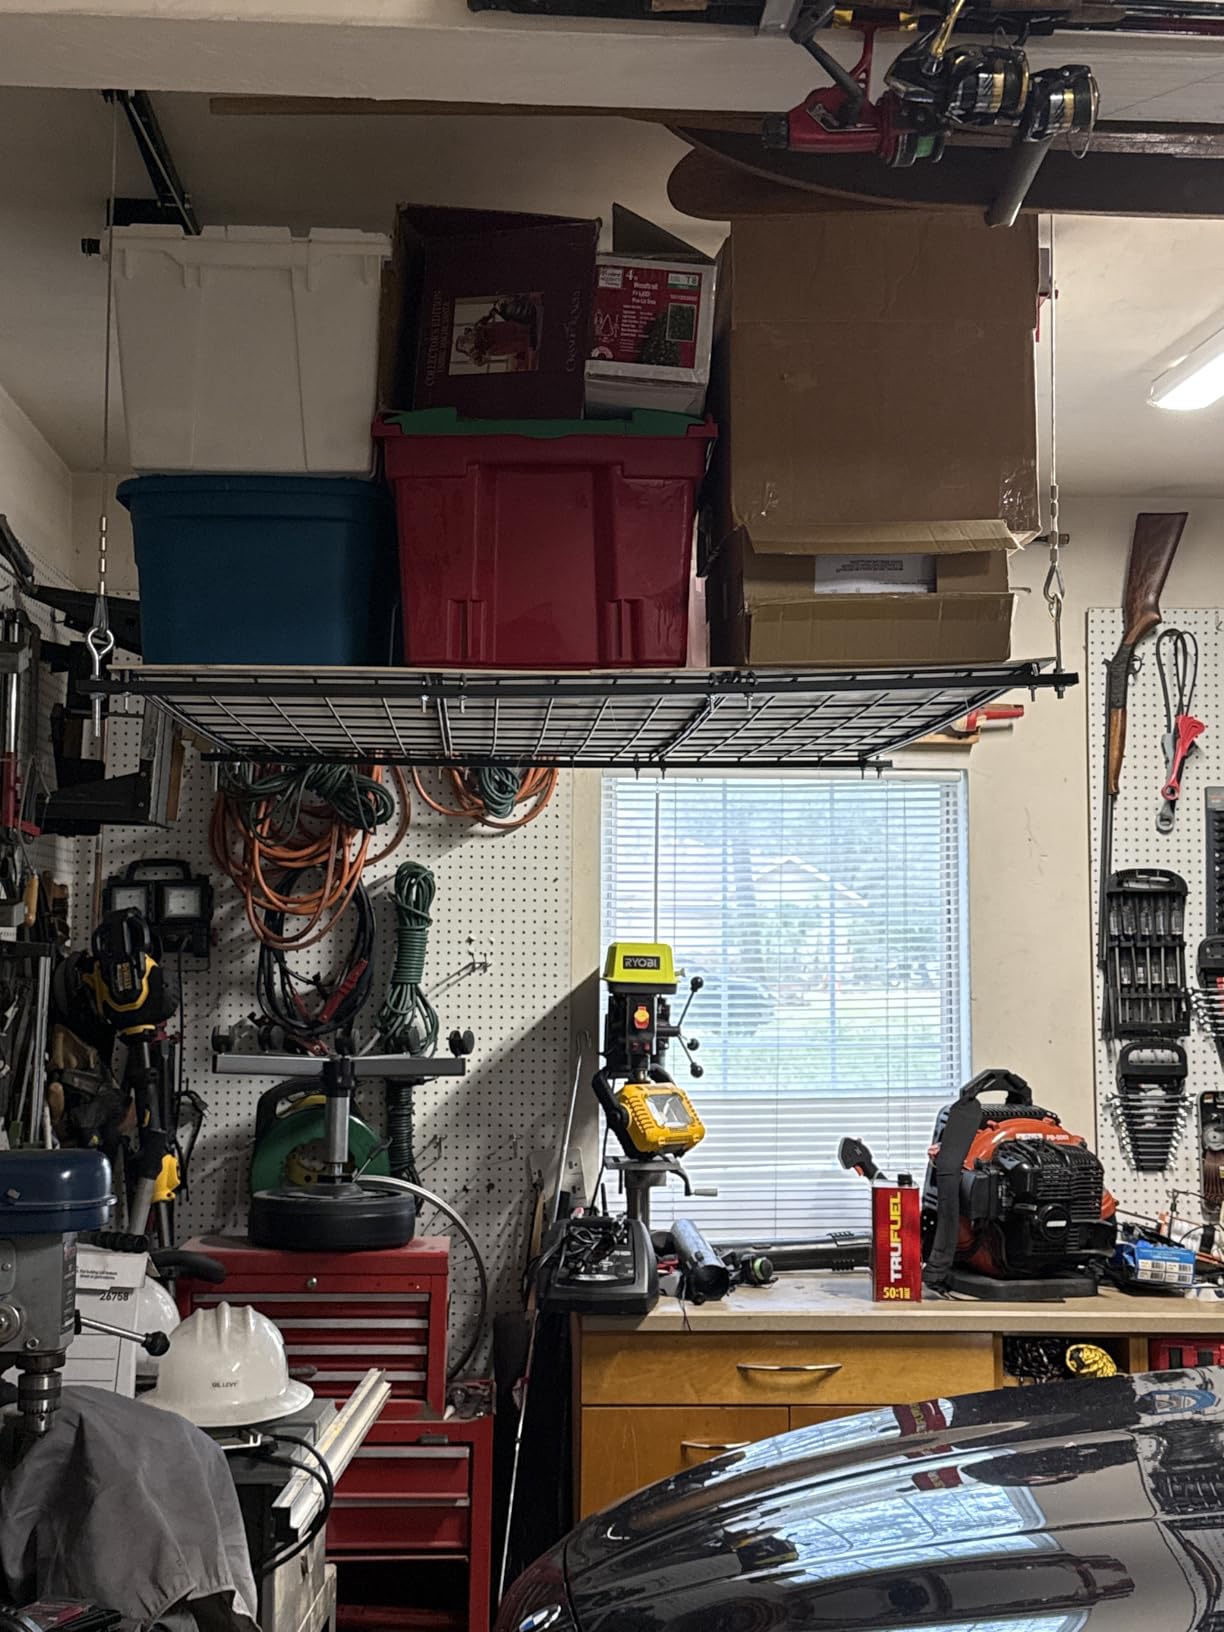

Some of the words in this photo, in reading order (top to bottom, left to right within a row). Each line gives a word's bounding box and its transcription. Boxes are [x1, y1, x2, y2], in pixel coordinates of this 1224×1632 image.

[625, 958, 658, 968] RYOBI
[890, 1191, 902, 1283] TRUFUEL
[100, 1291, 129, 1301] 26758
[883, 1287, 904, 1299] 50:1
